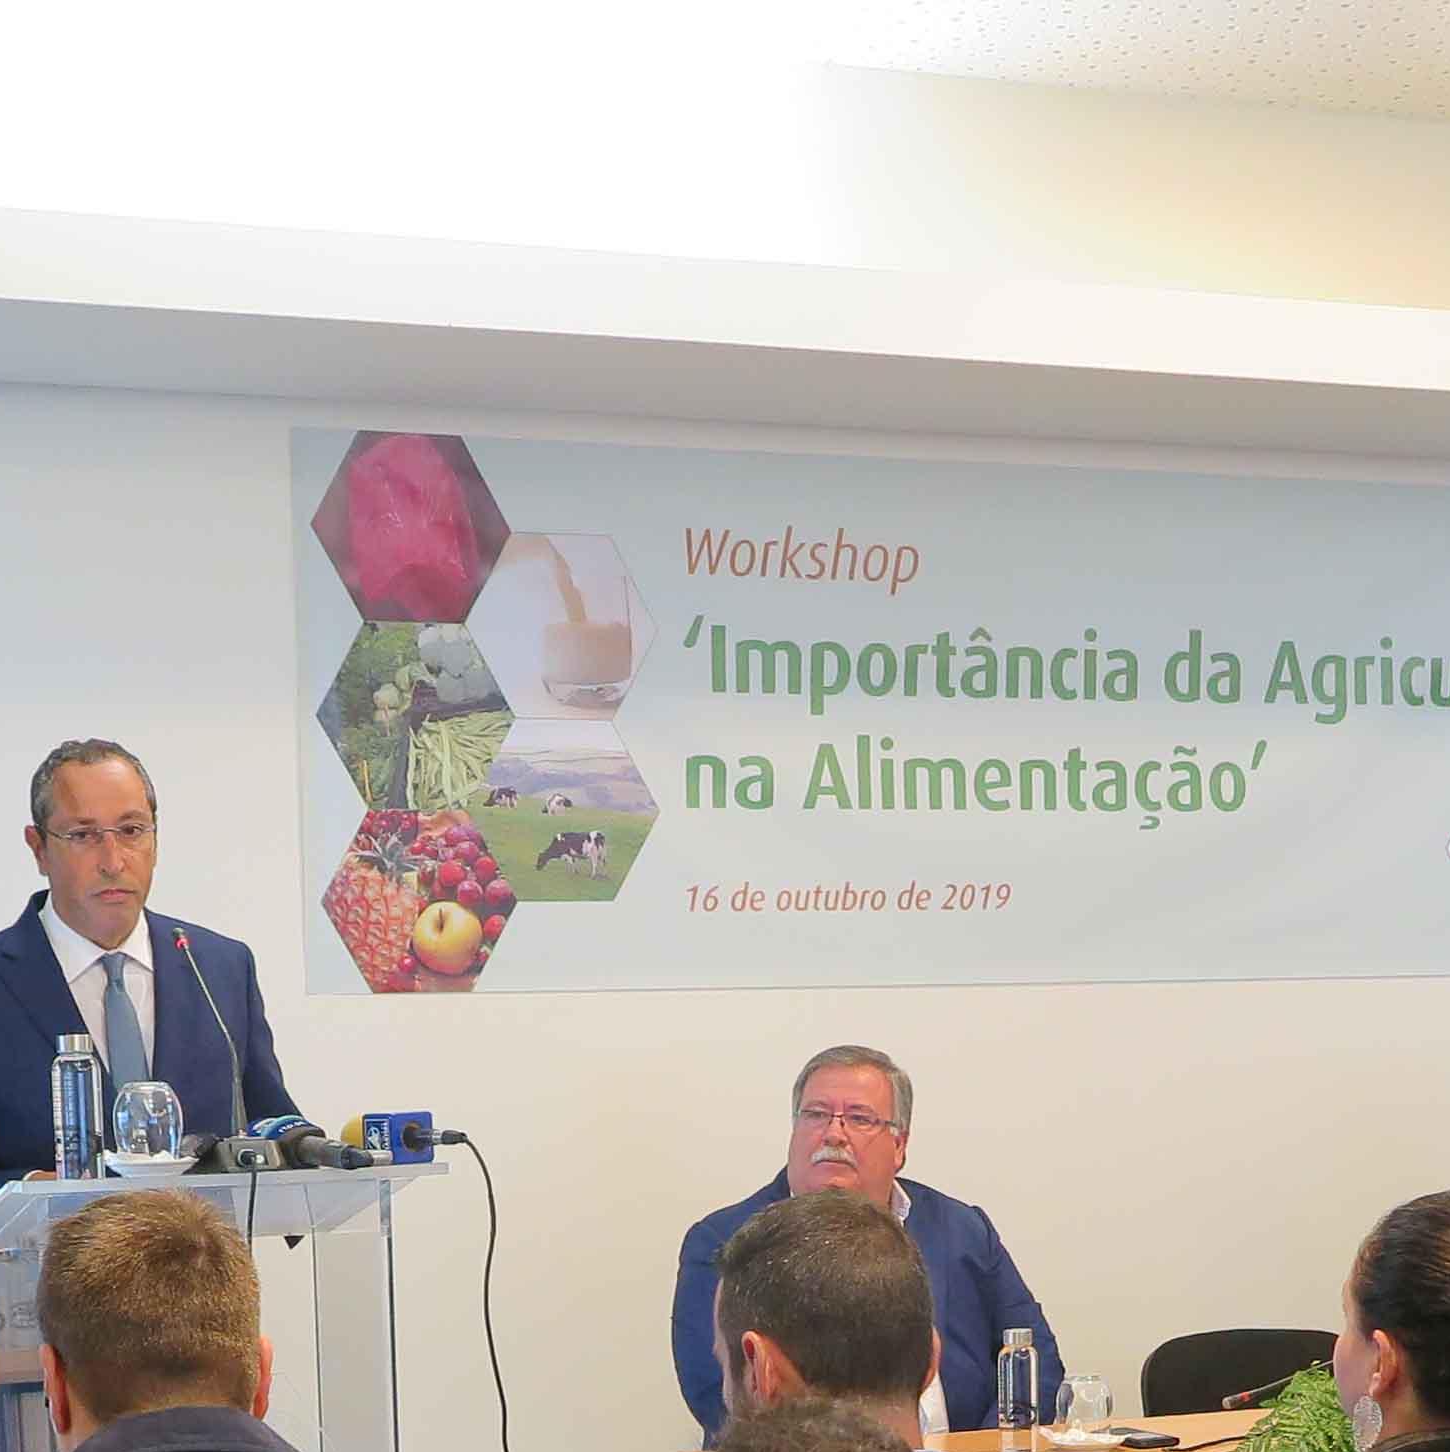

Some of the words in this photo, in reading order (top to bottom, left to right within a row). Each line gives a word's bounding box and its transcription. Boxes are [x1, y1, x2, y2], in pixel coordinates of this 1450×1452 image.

[684, 525, 920, 595] Workshop
[682, 615, 1139, 716] 'Importância
[1163, 629, 1242, 704] da
[685, 753, 775, 810] na
[802, 734, 1268, 830] Alimentação'
[685, 884, 720, 912] 16
[730, 881, 767, 912] de
[776, 881, 887, 912] outubro
[896, 880, 932, 911] de
[940, 883, 1012, 911] 2019
